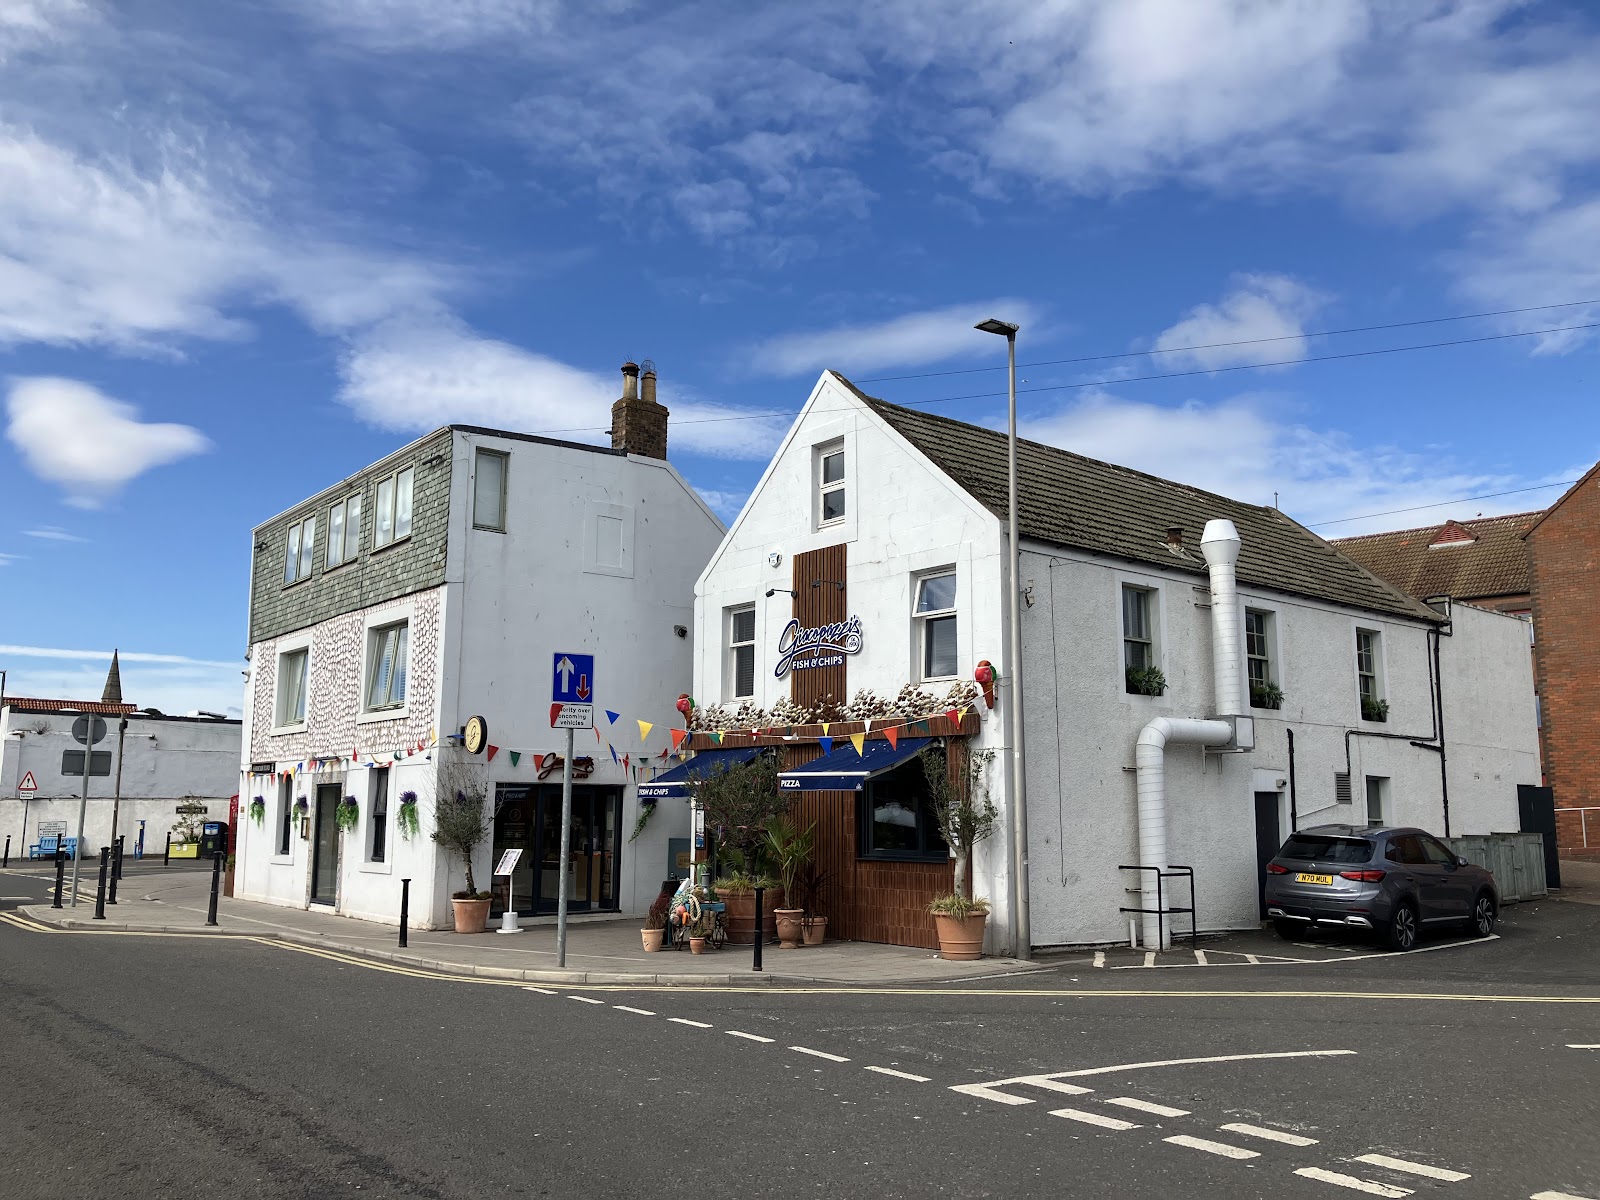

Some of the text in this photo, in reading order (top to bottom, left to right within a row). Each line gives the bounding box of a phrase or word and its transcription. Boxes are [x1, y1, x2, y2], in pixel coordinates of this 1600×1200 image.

[792, 655, 843, 670] FISH & CHIPS
[780, 780, 801, 788] PIZZA
[1315, 876, 1329, 884] MUL
